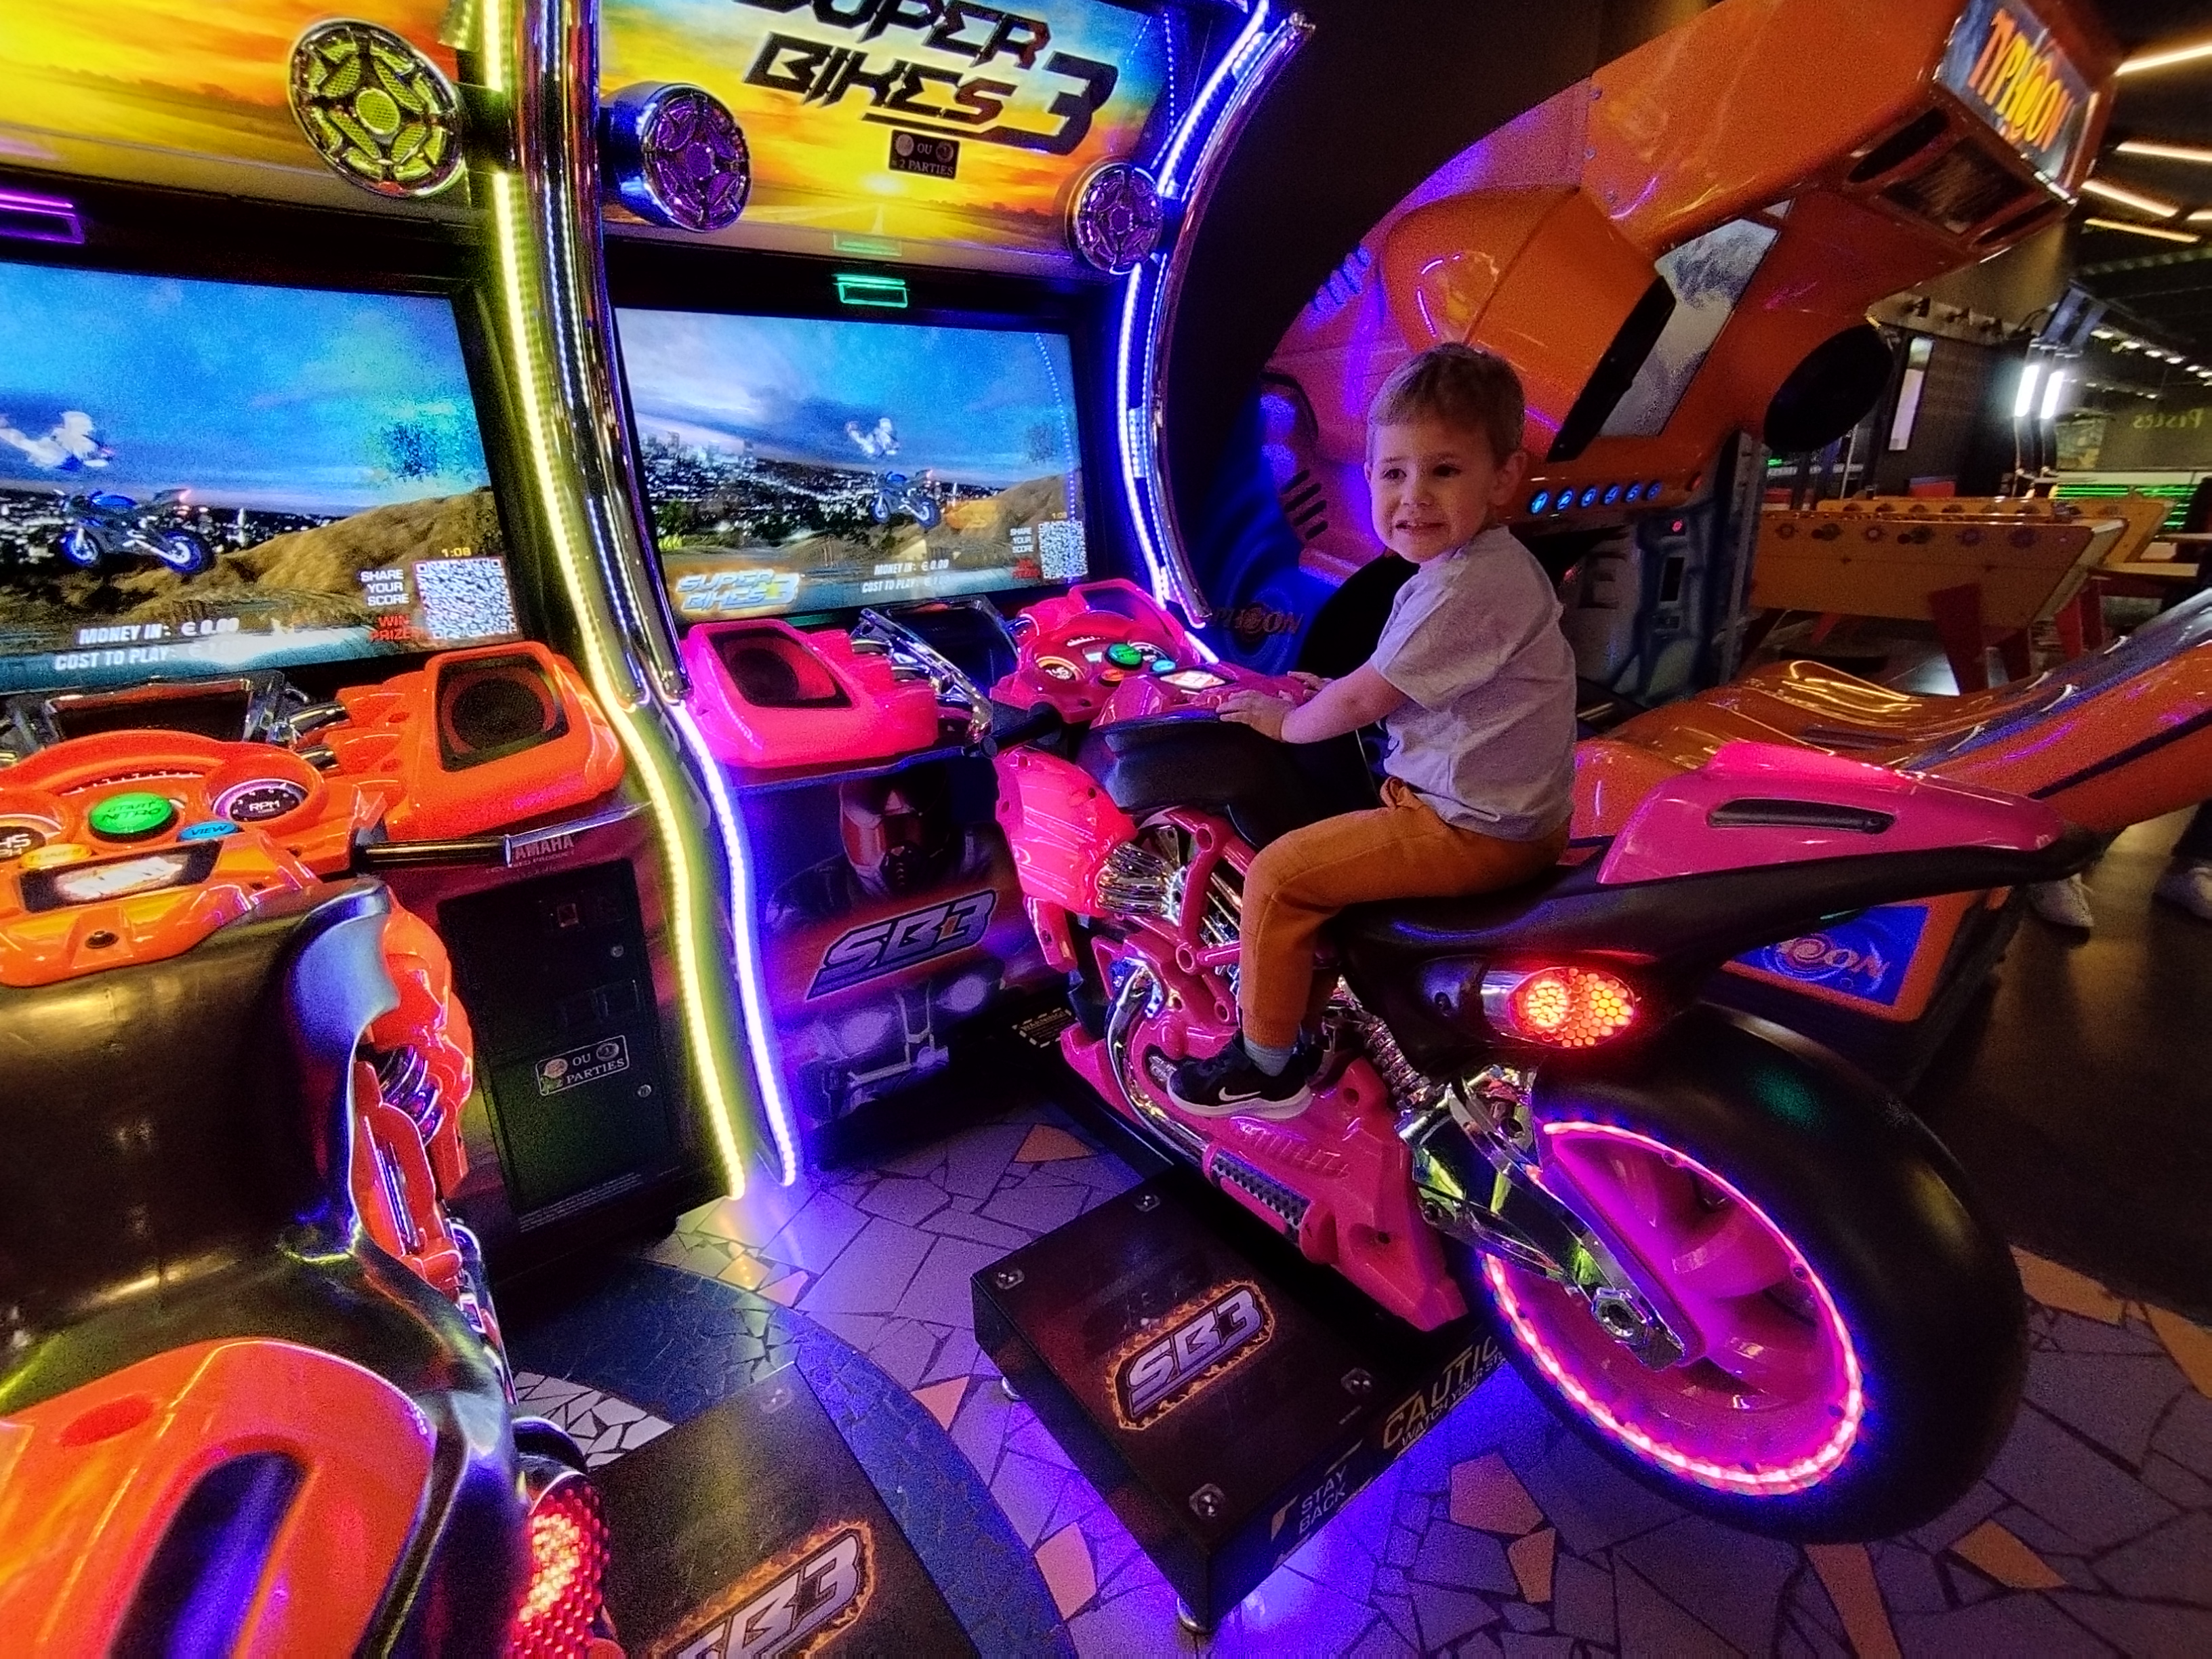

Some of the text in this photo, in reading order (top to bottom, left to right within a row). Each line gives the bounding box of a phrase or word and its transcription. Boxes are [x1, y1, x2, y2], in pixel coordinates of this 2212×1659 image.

[732, 0, 1050, 70] UPER
[742, 31, 1019, 125] BIKES
[917, 143, 933, 155] OU
[908, 160, 954, 176] PARTIES
[360, 569, 405, 582] SHARE
[874, 562, 902, 575] MONEY
[367, 581, 404, 594] YOUR
[676, 569, 775, 593] SUPER
[861, 581, 882, 594] COST
[884, 579, 895, 590] TO
[367, 594, 410, 607] SCORE
[682, 585, 766, 611] BIKES
[78, 625, 141, 644] MONEY
[201, 617, 240, 634] 0.00
[377, 615, 410, 628] WIN
[54, 651, 100, 671] COST
[105, 650, 126, 666] TO
[102, 808, 161, 822] NITRO
[249, 800, 281, 812] RPM
[190, 824, 228, 836] VIEW
[514, 834, 575, 860] AMAHA
[807, 889, 996, 1000] SB3
[573, 1053, 591, 1066] OU
[567, 1058, 625, 1084] PARTIES
[1128, 1289, 1262, 1418] SB3
[1402, 1398, 1449, 1446] WATCH
[1452, 1368, 1483, 1400] YOUR
[1302, 1465, 1347, 1515] STAY
[1299, 1482, 1346, 1534] BACK
